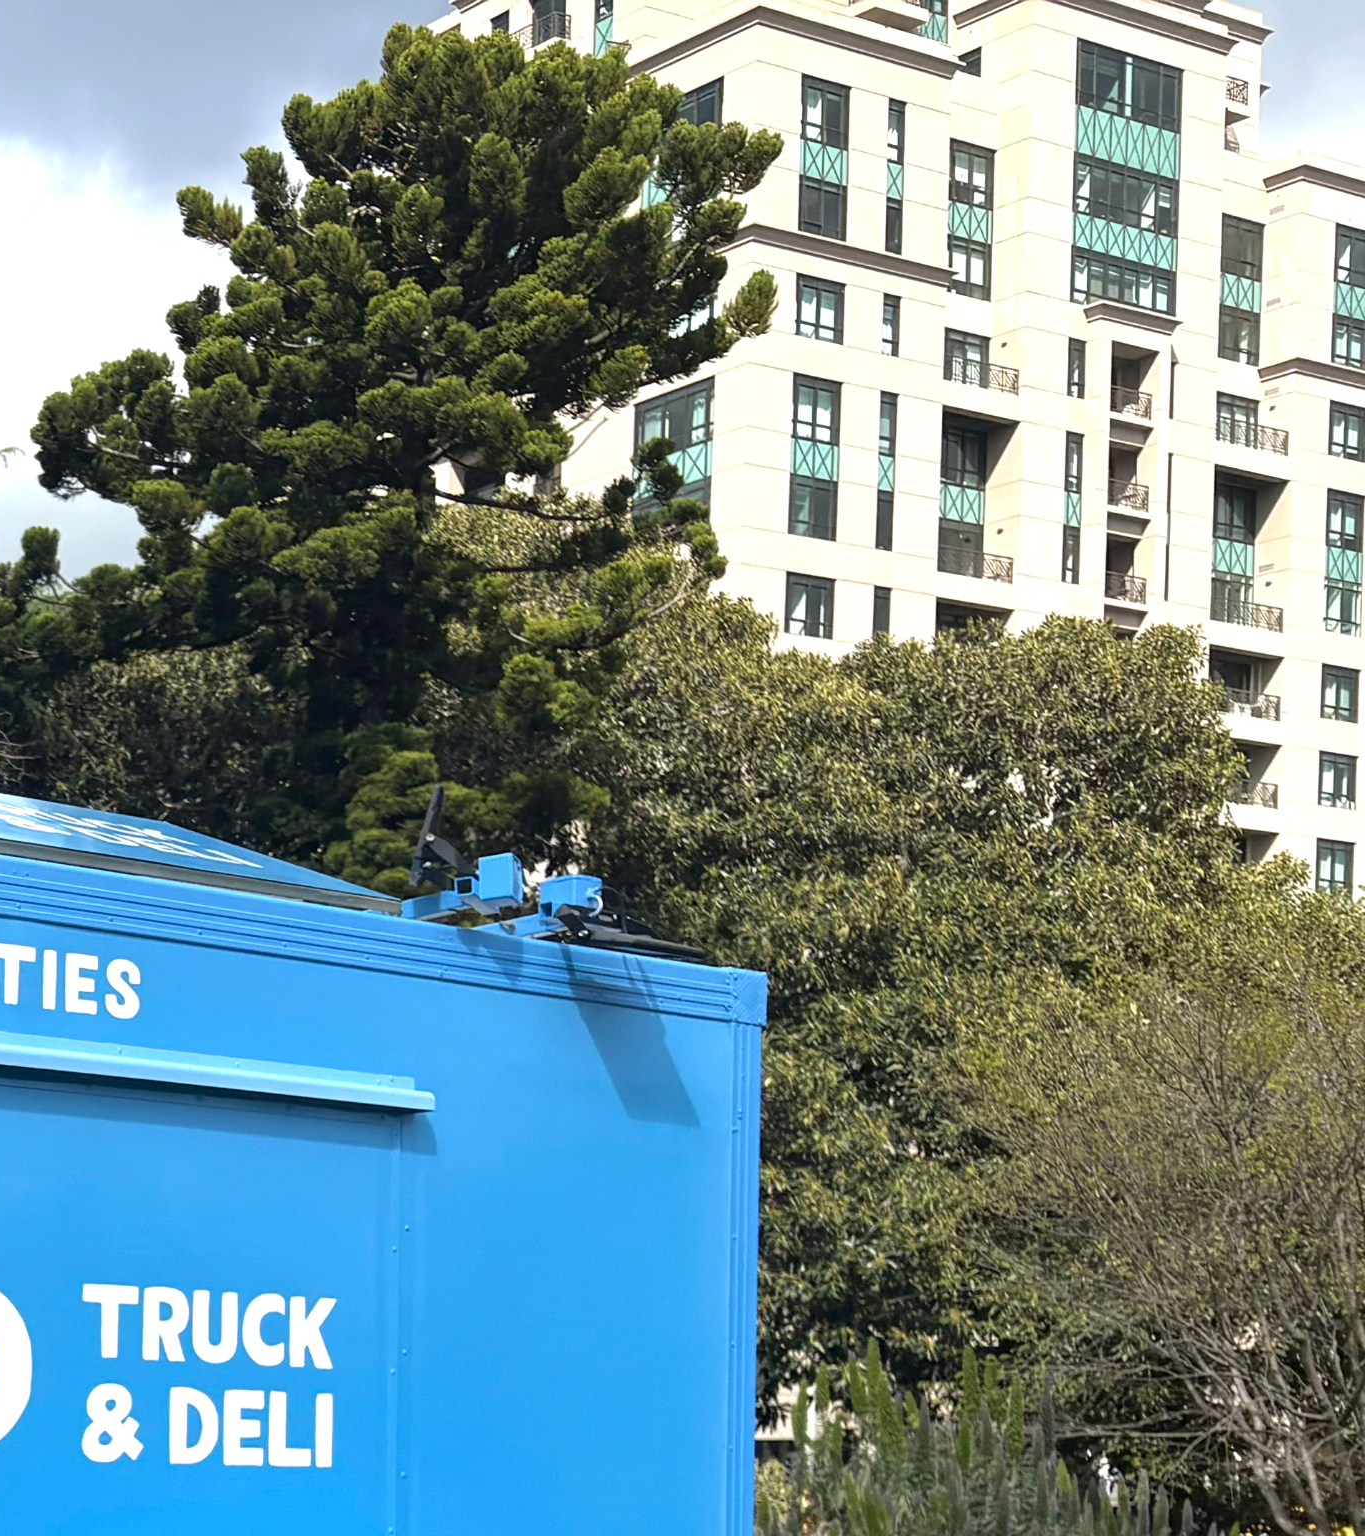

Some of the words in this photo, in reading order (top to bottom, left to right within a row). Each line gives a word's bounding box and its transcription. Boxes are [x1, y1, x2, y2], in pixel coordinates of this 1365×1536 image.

[82, 1284, 336, 1369] TRUCK
[82, 1384, 143, 1462] &
[169, 1387, 333, 1467] DELI
